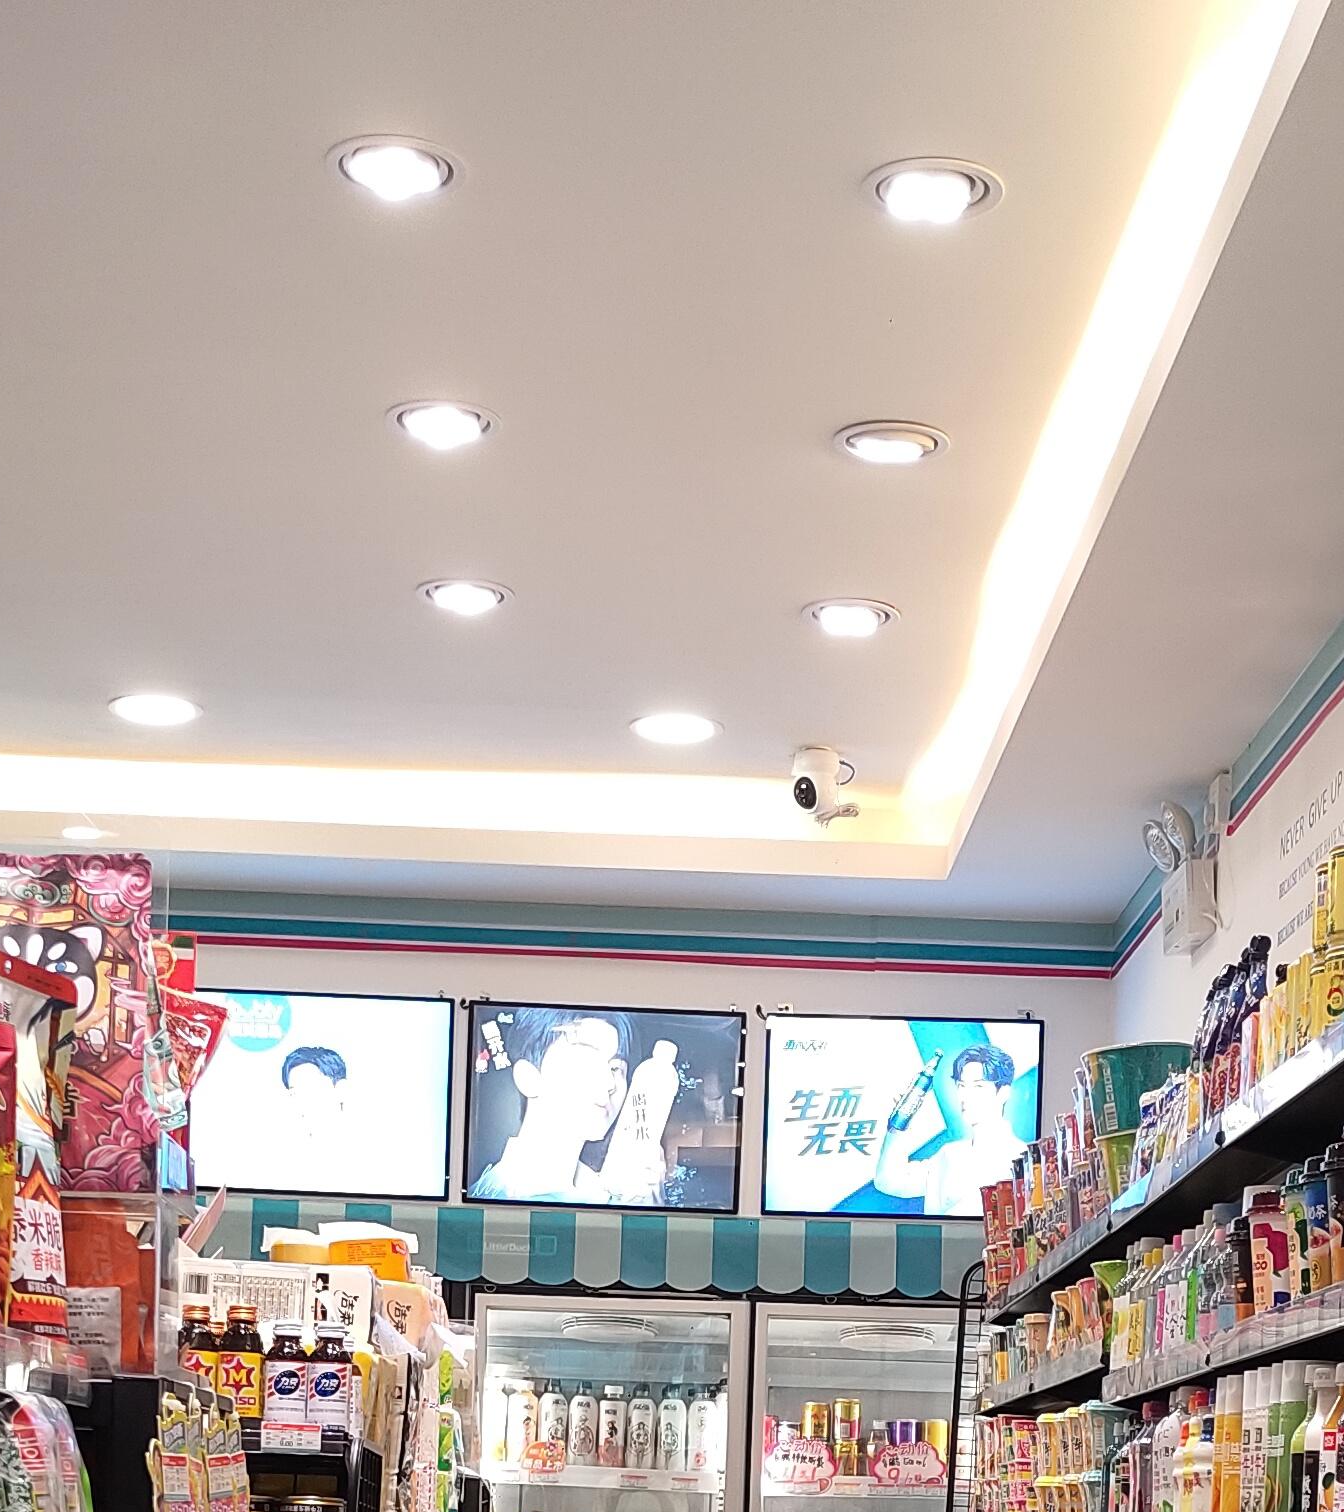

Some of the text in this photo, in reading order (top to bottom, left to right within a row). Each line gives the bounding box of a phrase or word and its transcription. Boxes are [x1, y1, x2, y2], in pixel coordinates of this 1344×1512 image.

[1280, 770, 1343, 860] NEVER GIVE UP
[784, 1086, 864, 1122] 生而
[798, 1121, 878, 1157] 无畏
